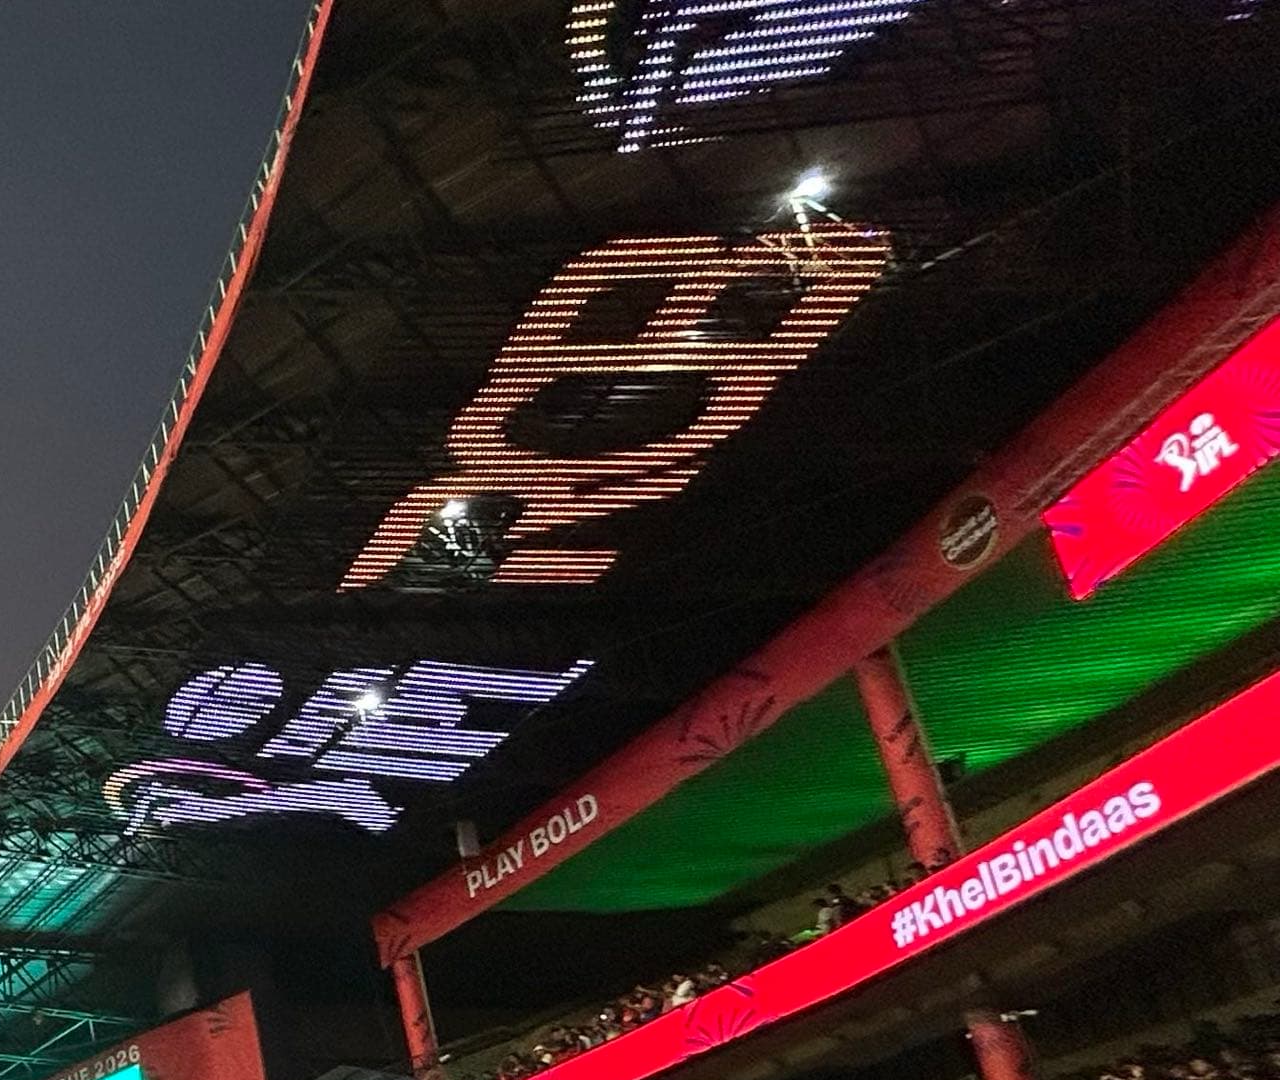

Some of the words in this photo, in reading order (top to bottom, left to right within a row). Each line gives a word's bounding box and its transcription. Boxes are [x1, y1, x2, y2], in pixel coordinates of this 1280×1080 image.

[336, 223, 892, 592] RCB
[466, 839, 524, 898] PLAY
[529, 794, 599, 857] BOLD
[891, 781, 1162, 949] #KhelBindaas
[93, 1044, 141, 1079] 2026
